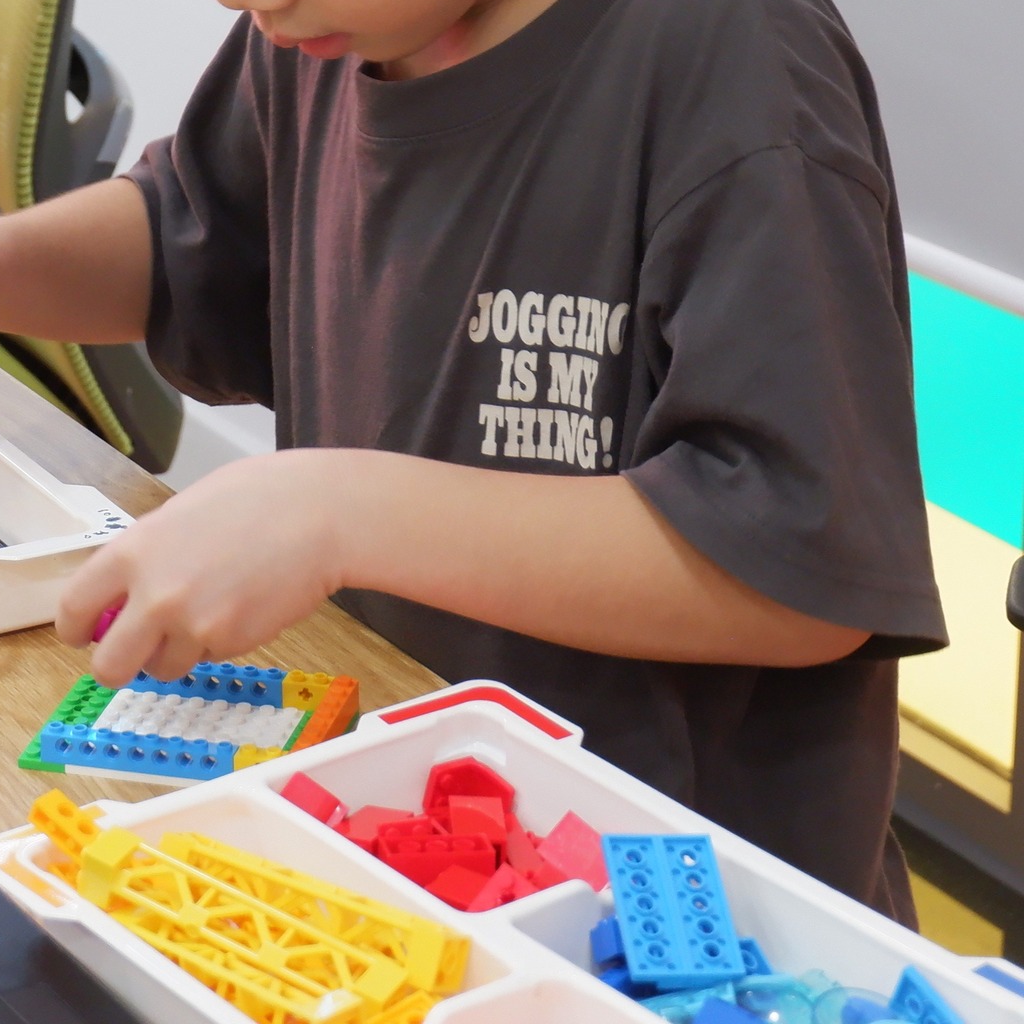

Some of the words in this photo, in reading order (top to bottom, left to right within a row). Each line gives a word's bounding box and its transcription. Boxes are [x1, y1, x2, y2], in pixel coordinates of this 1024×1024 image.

[497, 348, 538, 402] IS
[547, 351, 599, 411] MY
[478, 403, 614, 470] THING!
